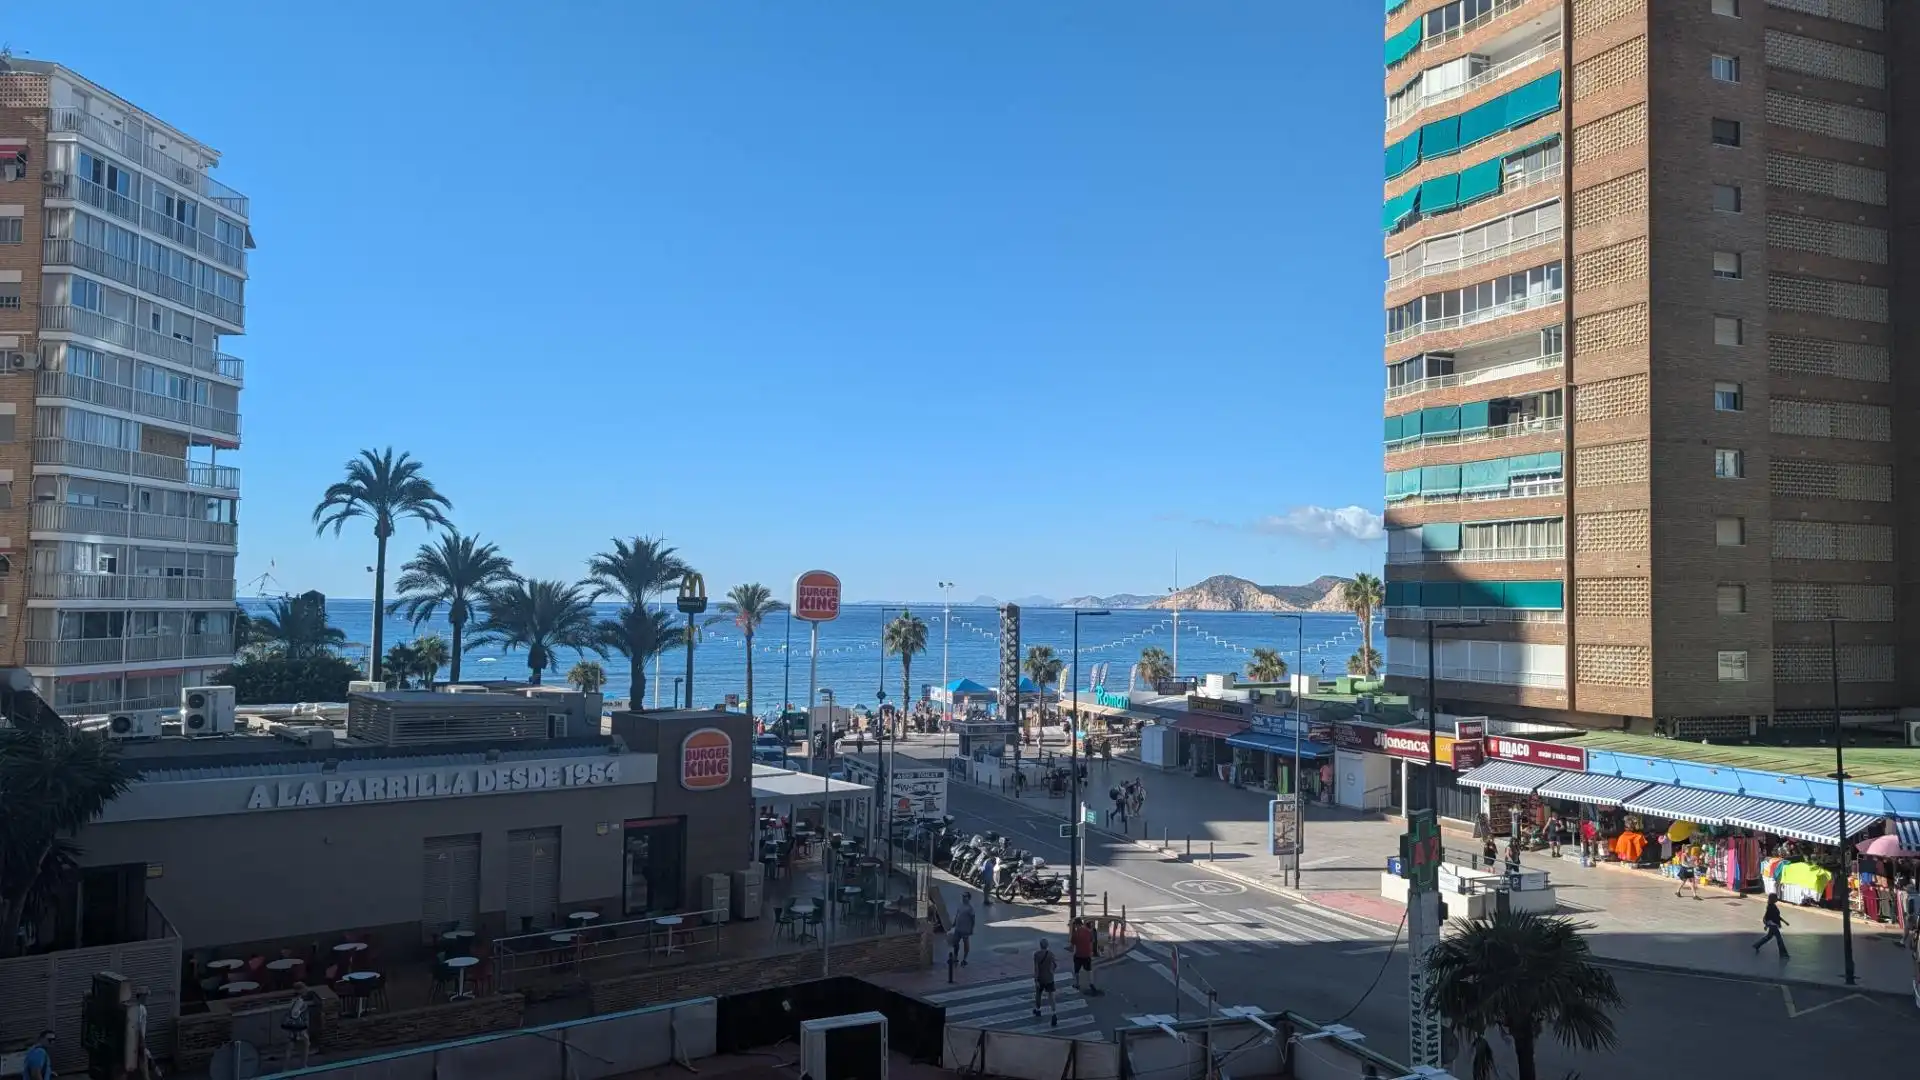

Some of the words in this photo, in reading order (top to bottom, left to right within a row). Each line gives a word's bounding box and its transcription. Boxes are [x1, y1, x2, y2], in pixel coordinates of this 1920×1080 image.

[799, 586, 838, 597] BURGER
[799, 597, 838, 610] KING
[1096, 683, 1130, 709] Roman
[1374, 732, 1430, 753] Jijonenca
[1499, 740, 1530, 757] UDACO
[685, 747, 729, 761] BURGER
[685, 759, 729, 777] KING
[247, 784, 272, 809] A
[277, 781, 317, 807] LA
[324, 771, 476, 805] PARRILLA
[477, 763, 560, 793] DESDE
[564, 761, 621, 786] 1954
[1395, 862, 1401, 873] P
[1411, 973, 1422, 1066] ARMACIA
